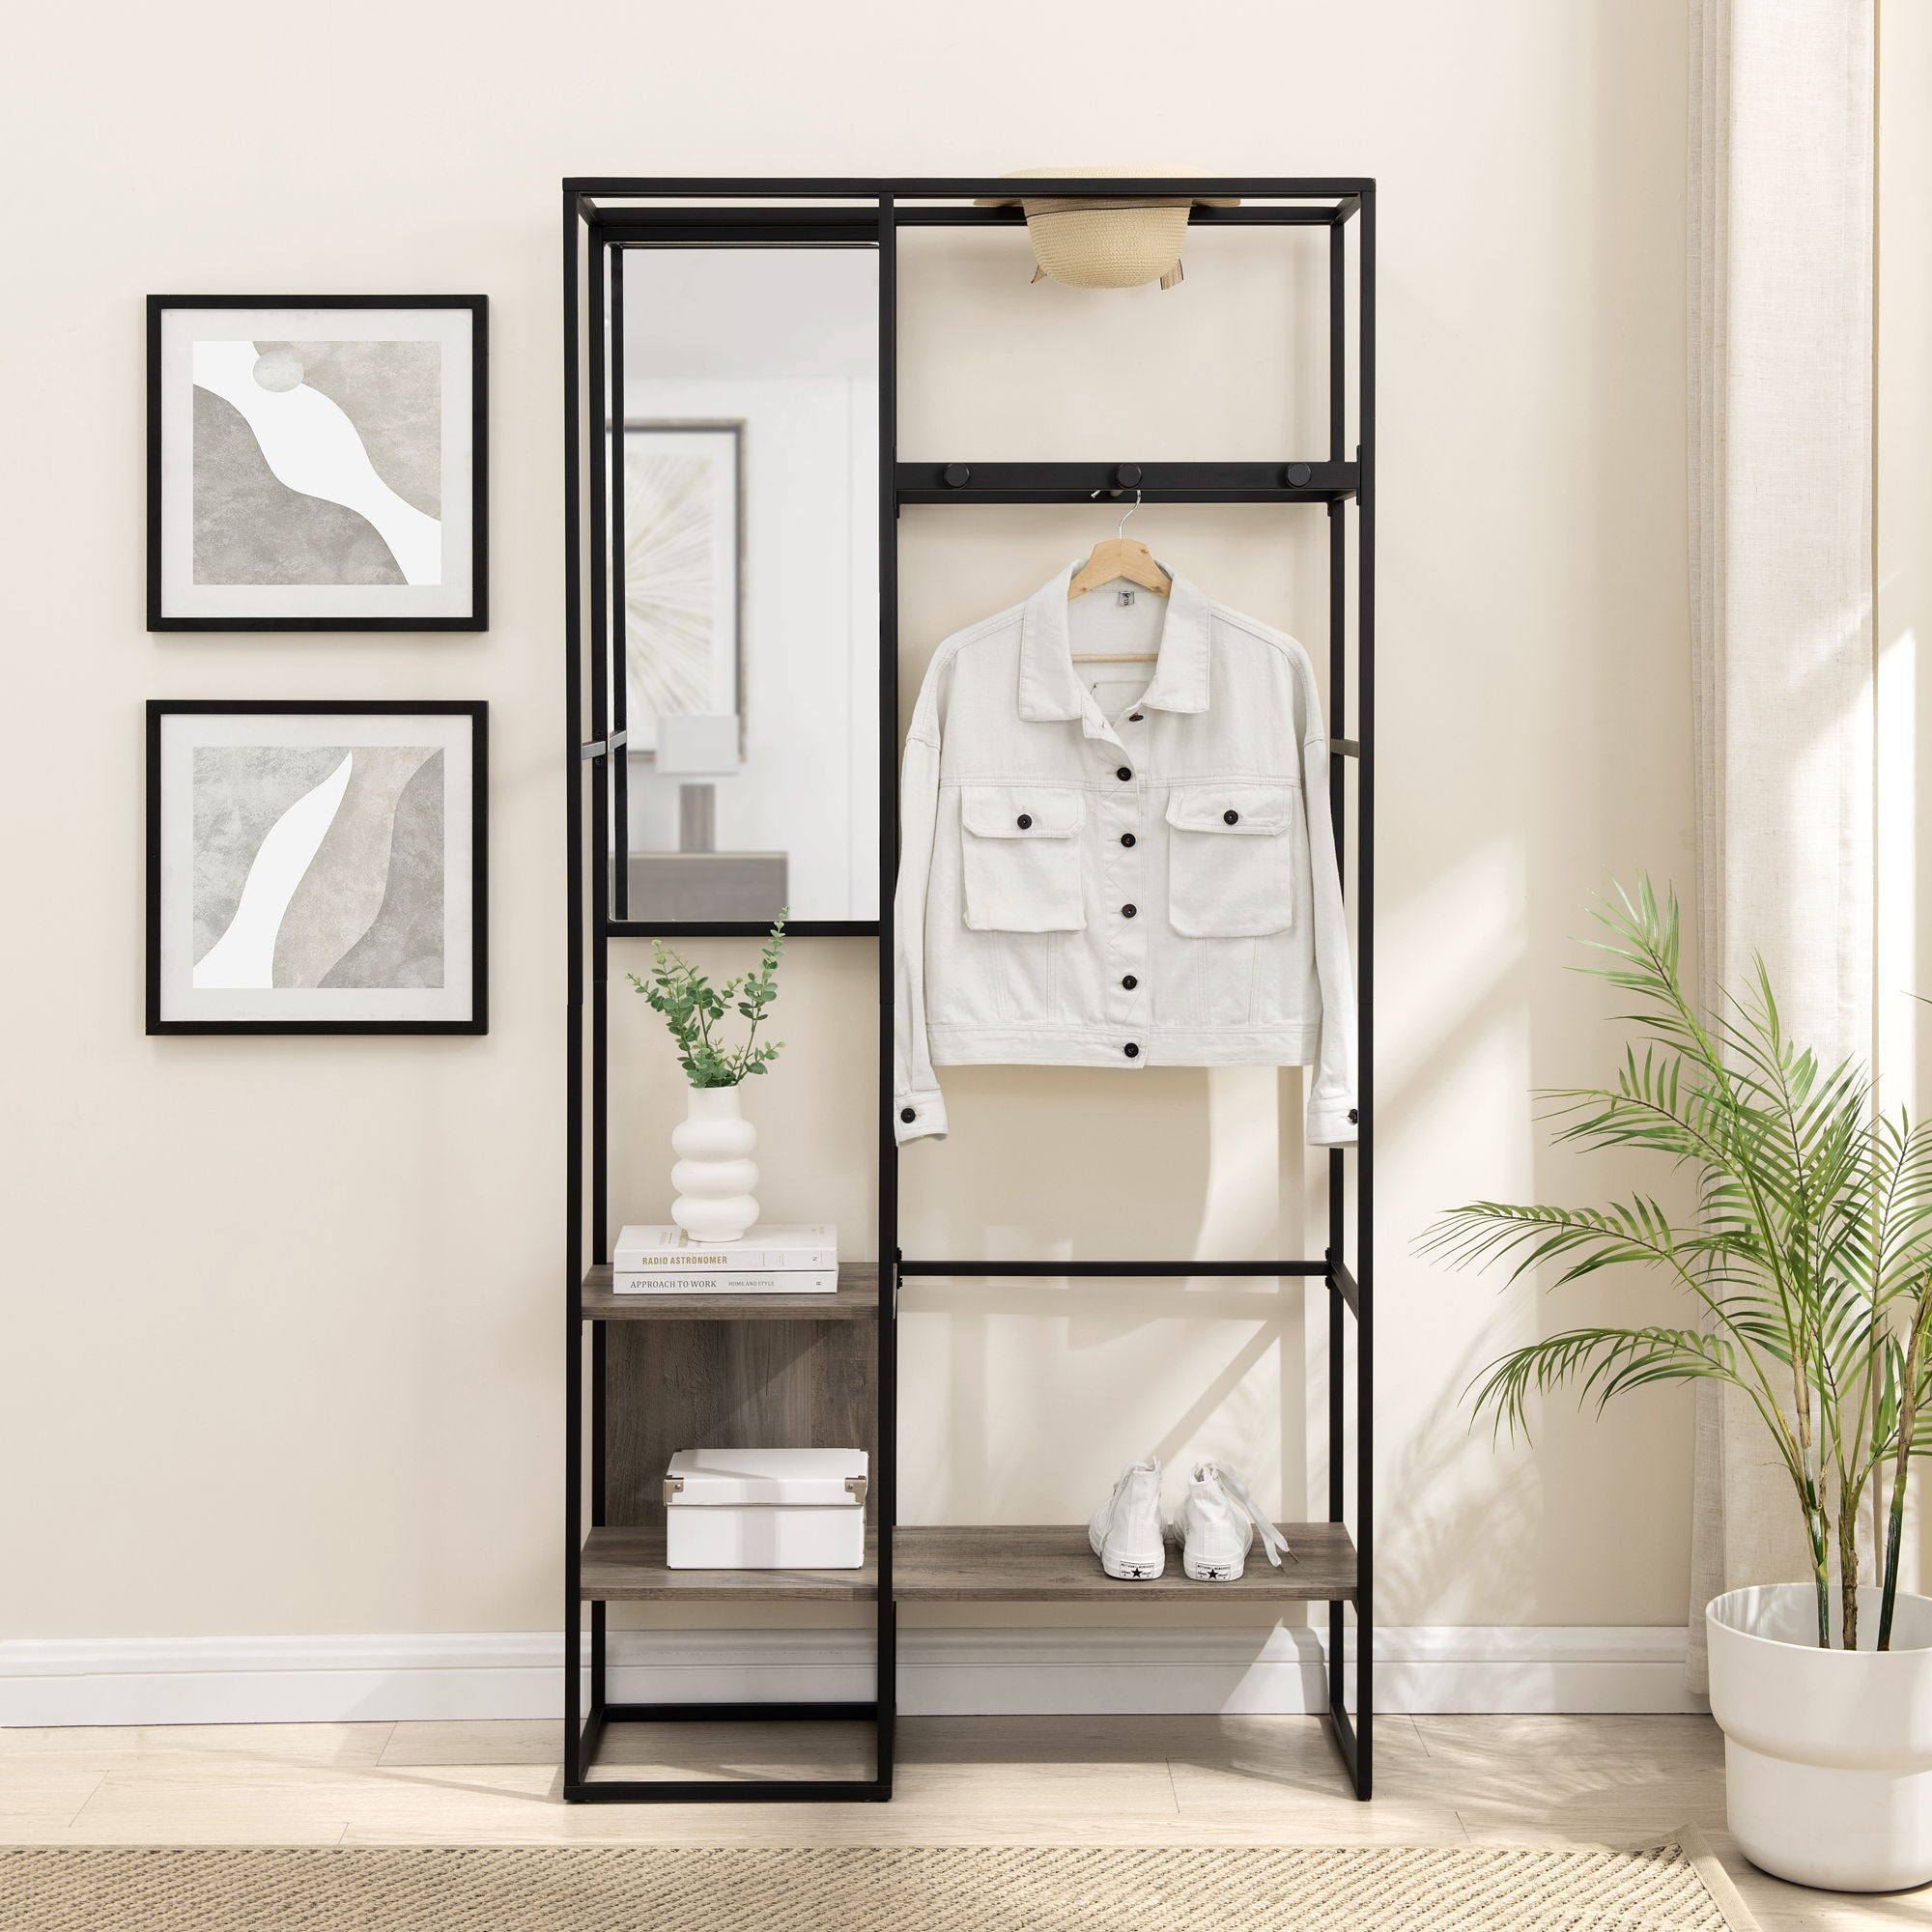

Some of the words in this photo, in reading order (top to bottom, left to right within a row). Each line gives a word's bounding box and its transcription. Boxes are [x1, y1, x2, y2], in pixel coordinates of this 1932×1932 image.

[641, 1257, 668, 1265] RADIO
[669, 1256, 727, 1264] ASTRONOMER
[630, 1280, 675, 1289] APPROACH
